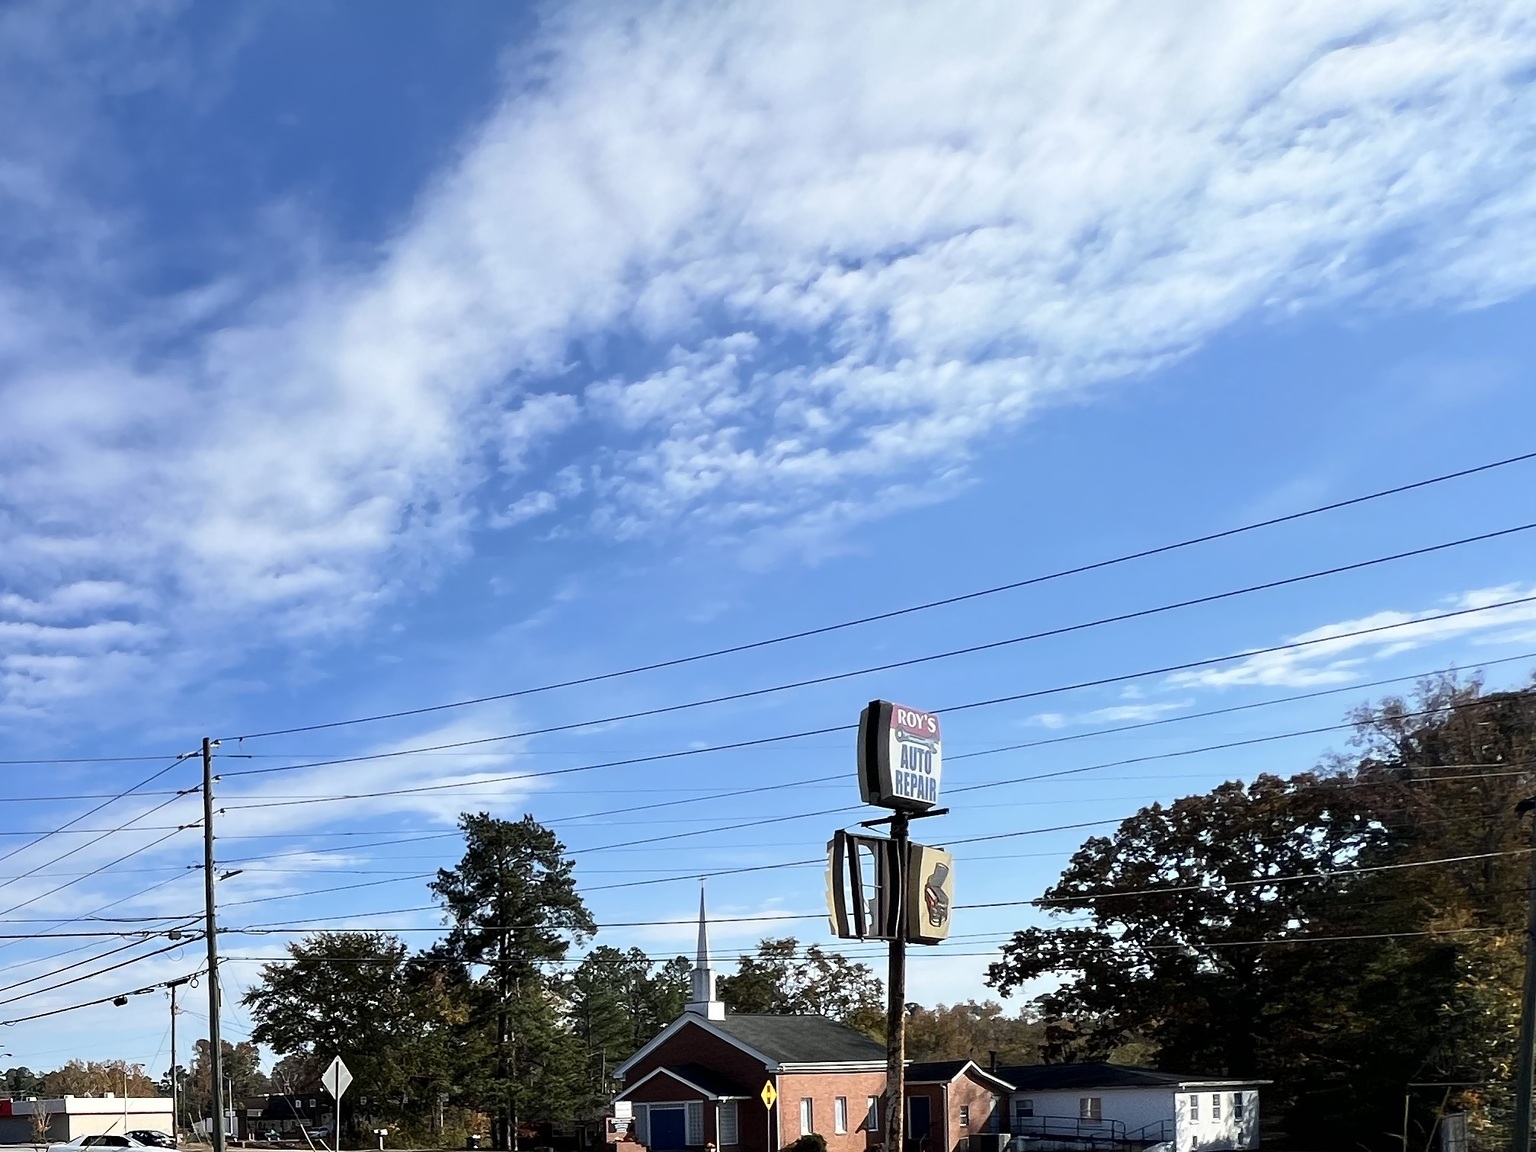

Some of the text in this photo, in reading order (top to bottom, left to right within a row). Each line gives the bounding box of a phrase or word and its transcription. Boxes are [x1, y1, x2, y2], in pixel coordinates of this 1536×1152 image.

[897, 708, 937, 733] ROY'S
[900, 744, 932, 775] AUTO
[895, 769, 937, 802] REPAIR
